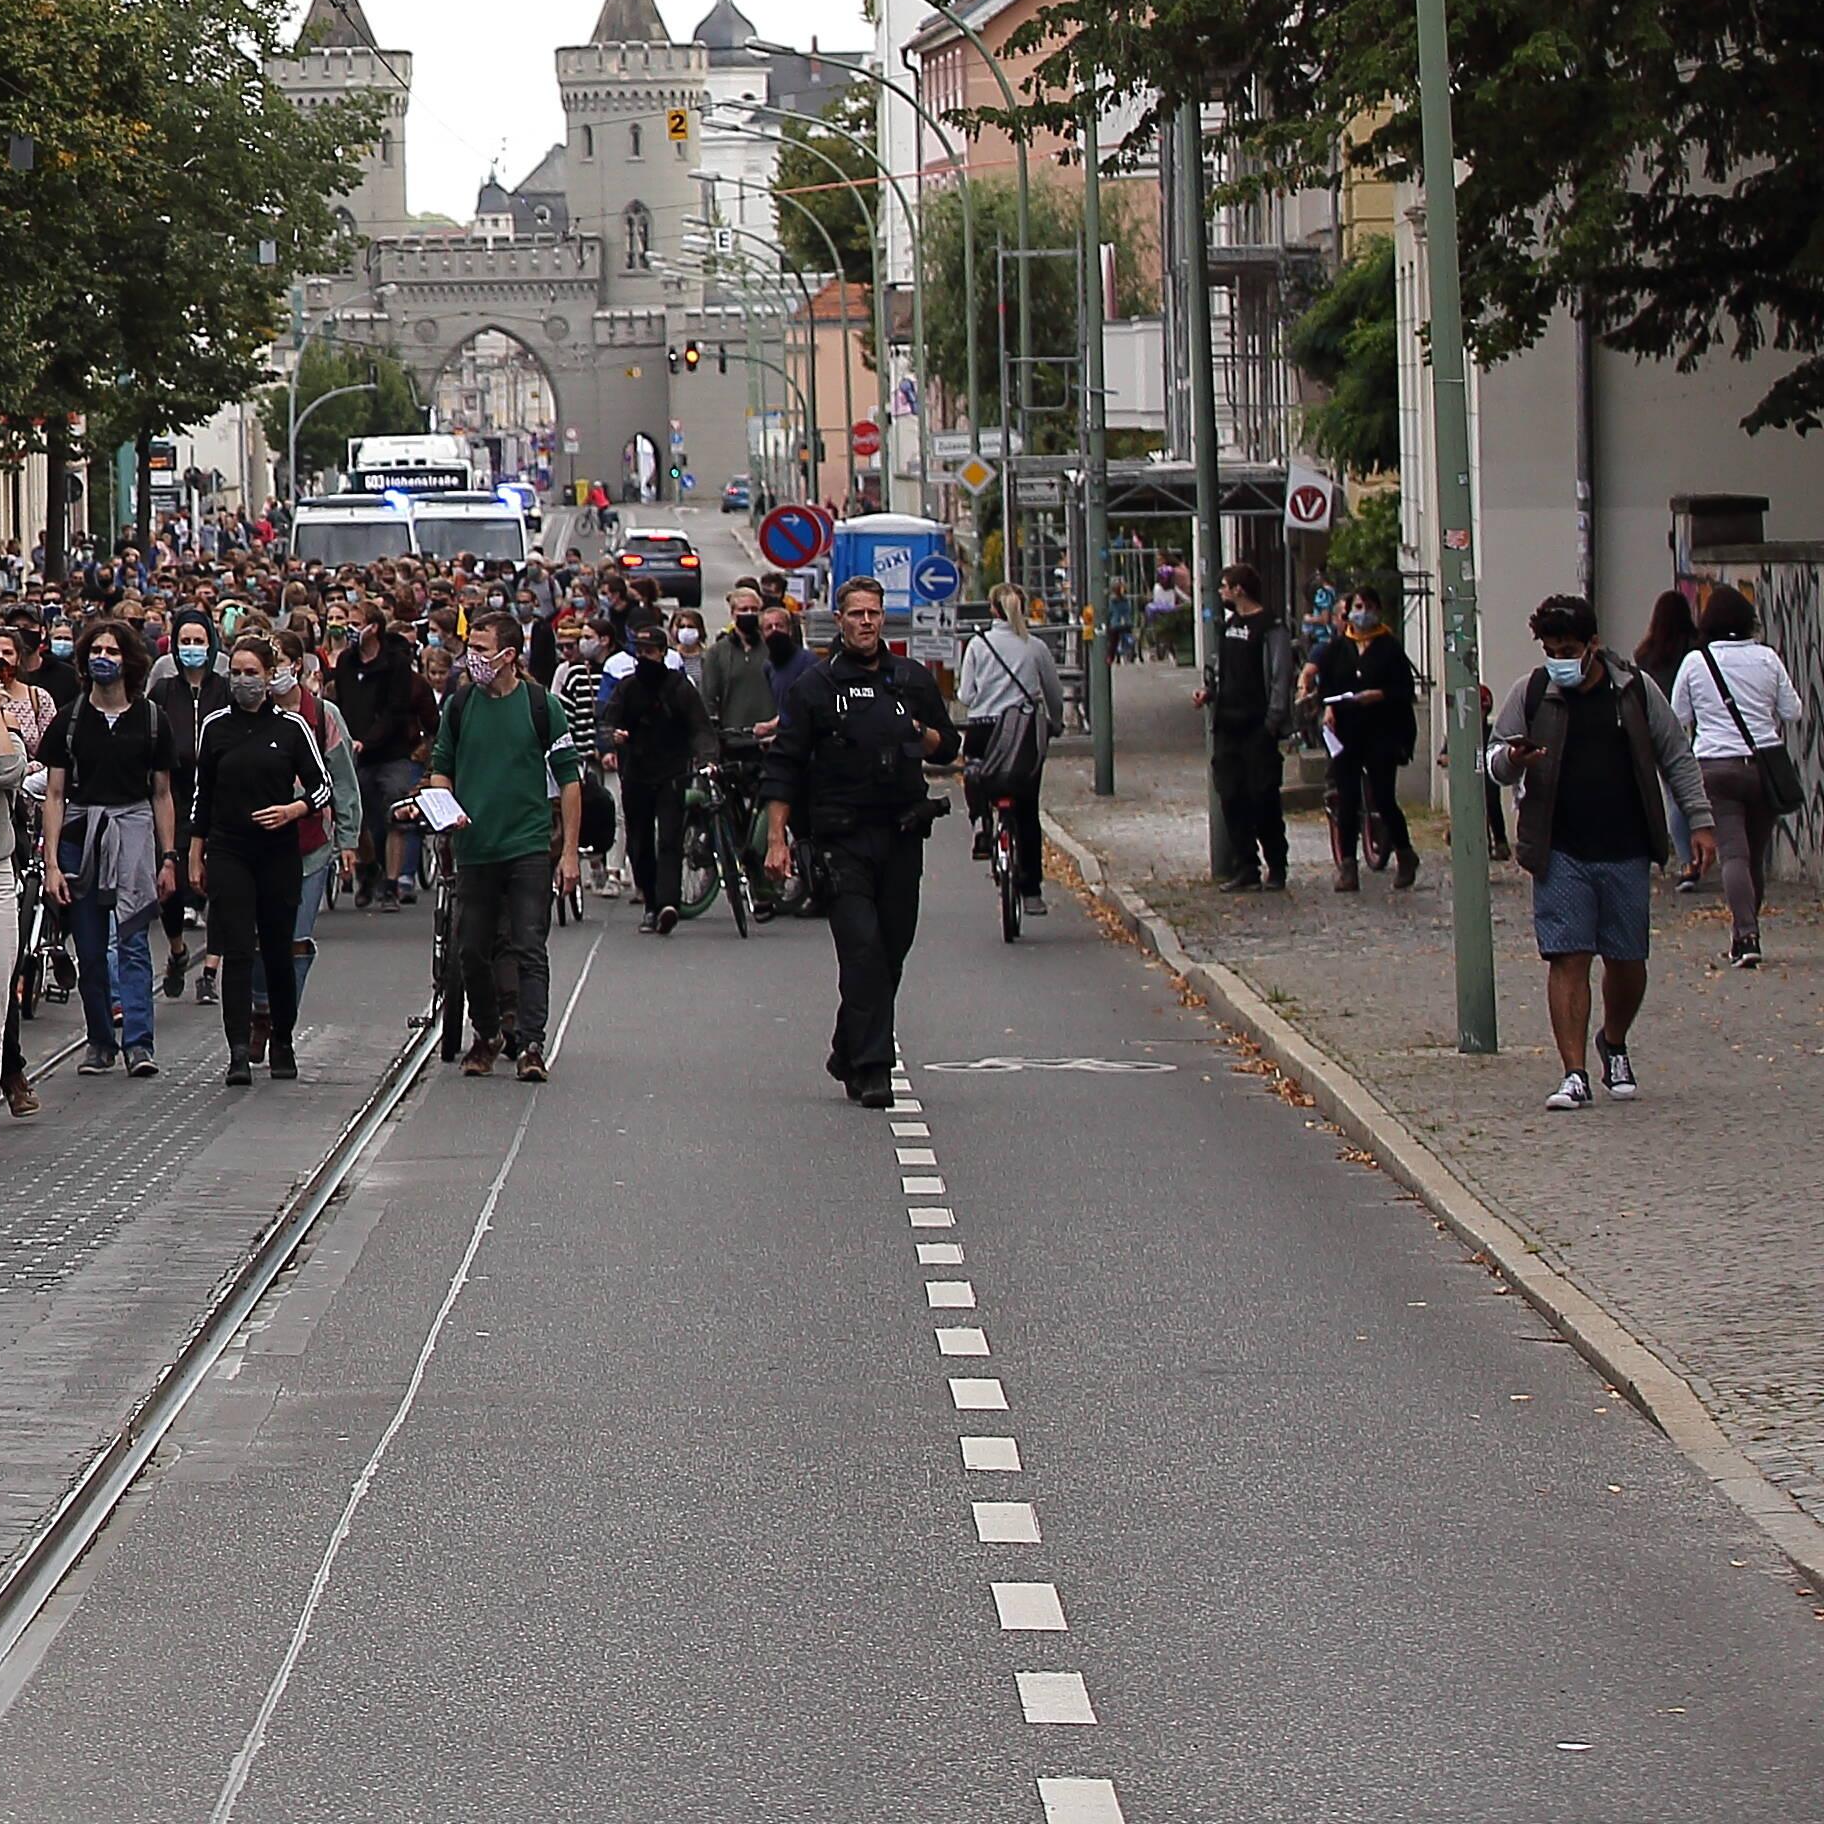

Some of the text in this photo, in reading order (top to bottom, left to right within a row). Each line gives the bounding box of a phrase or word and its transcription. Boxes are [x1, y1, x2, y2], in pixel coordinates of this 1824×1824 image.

[670, 114, 686, 134] 2
[718, 232, 730, 248] E
[1295, 494, 1322, 520] V
[874, 550, 910, 573] DIXI
[849, 687, 874, 698] POLIZEI
